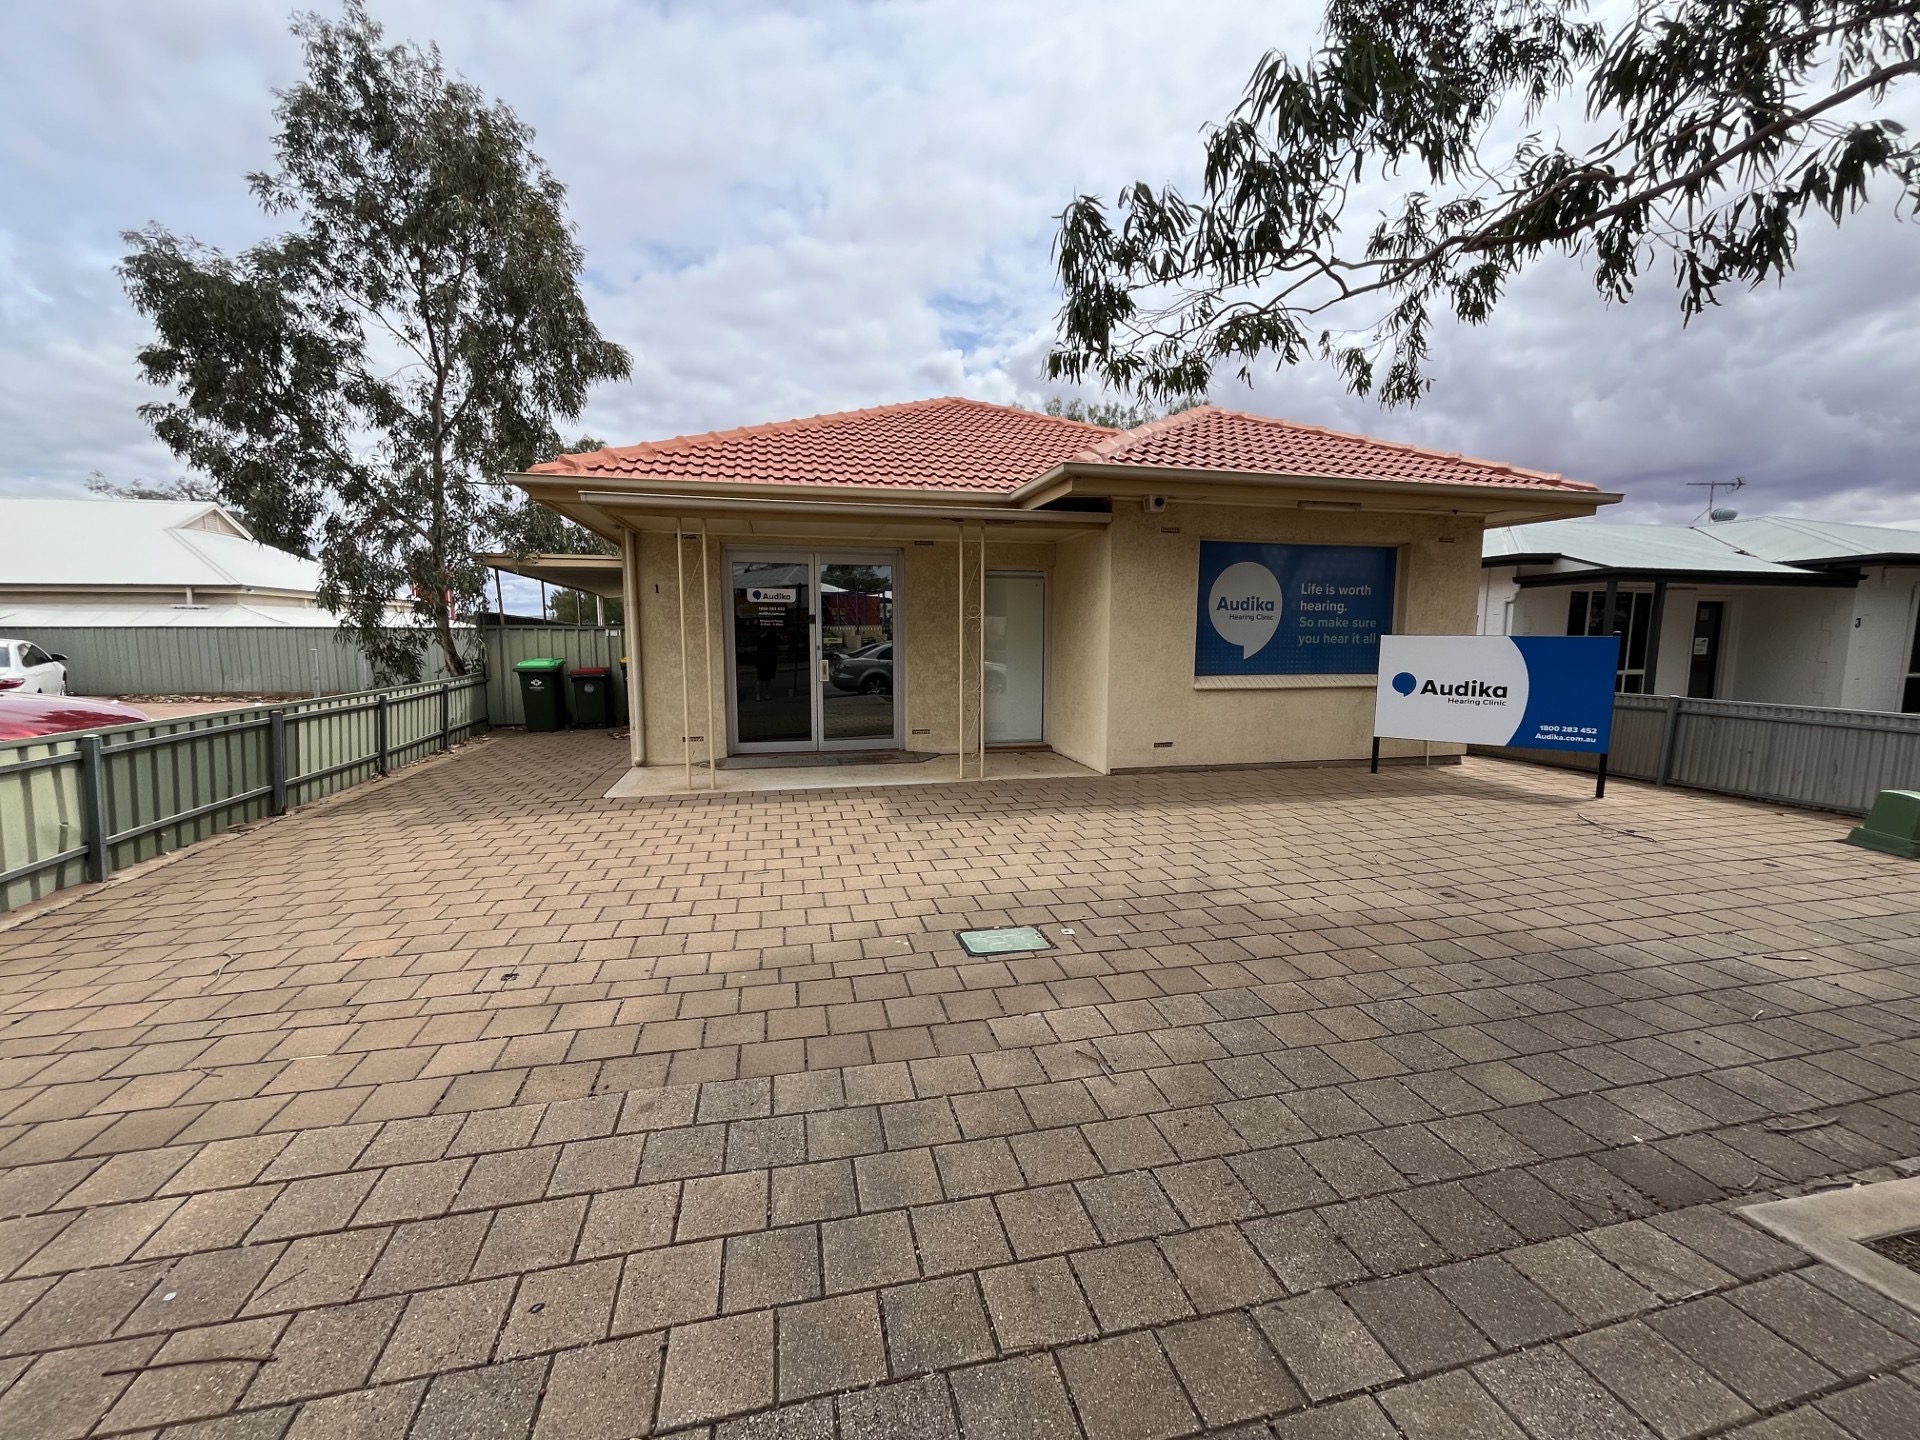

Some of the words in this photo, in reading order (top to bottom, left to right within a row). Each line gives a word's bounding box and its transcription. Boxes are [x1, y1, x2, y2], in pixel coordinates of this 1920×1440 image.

[1301, 583, 1323, 595] Life
[1326, 584, 1335, 595] is
[1338, 585, 1372, 596] worth
[762, 592, 791, 600] Audika
[1216, 596, 1275, 612] Audika
[1300, 600, 1348, 614] hearing.
[1229, 613, 1255, 621] Hearing
[1256, 613, 1274, 621] Clinic
[1299, 616, 1314, 628] So
[1318, 617, 1349, 628] make
[1352, 619, 1377, 628] sure
[1298, 634, 1320, 646] you
[1323, 632, 1349, 644] hear
[1352, 632, 1360, 644] it
[1363, 632, 1376, 644] all
[1420, 680, 1508, 698] Audika
[1447, 698, 1480, 706] Hearing
[1535, 732, 1597, 743] Audika.com.au
